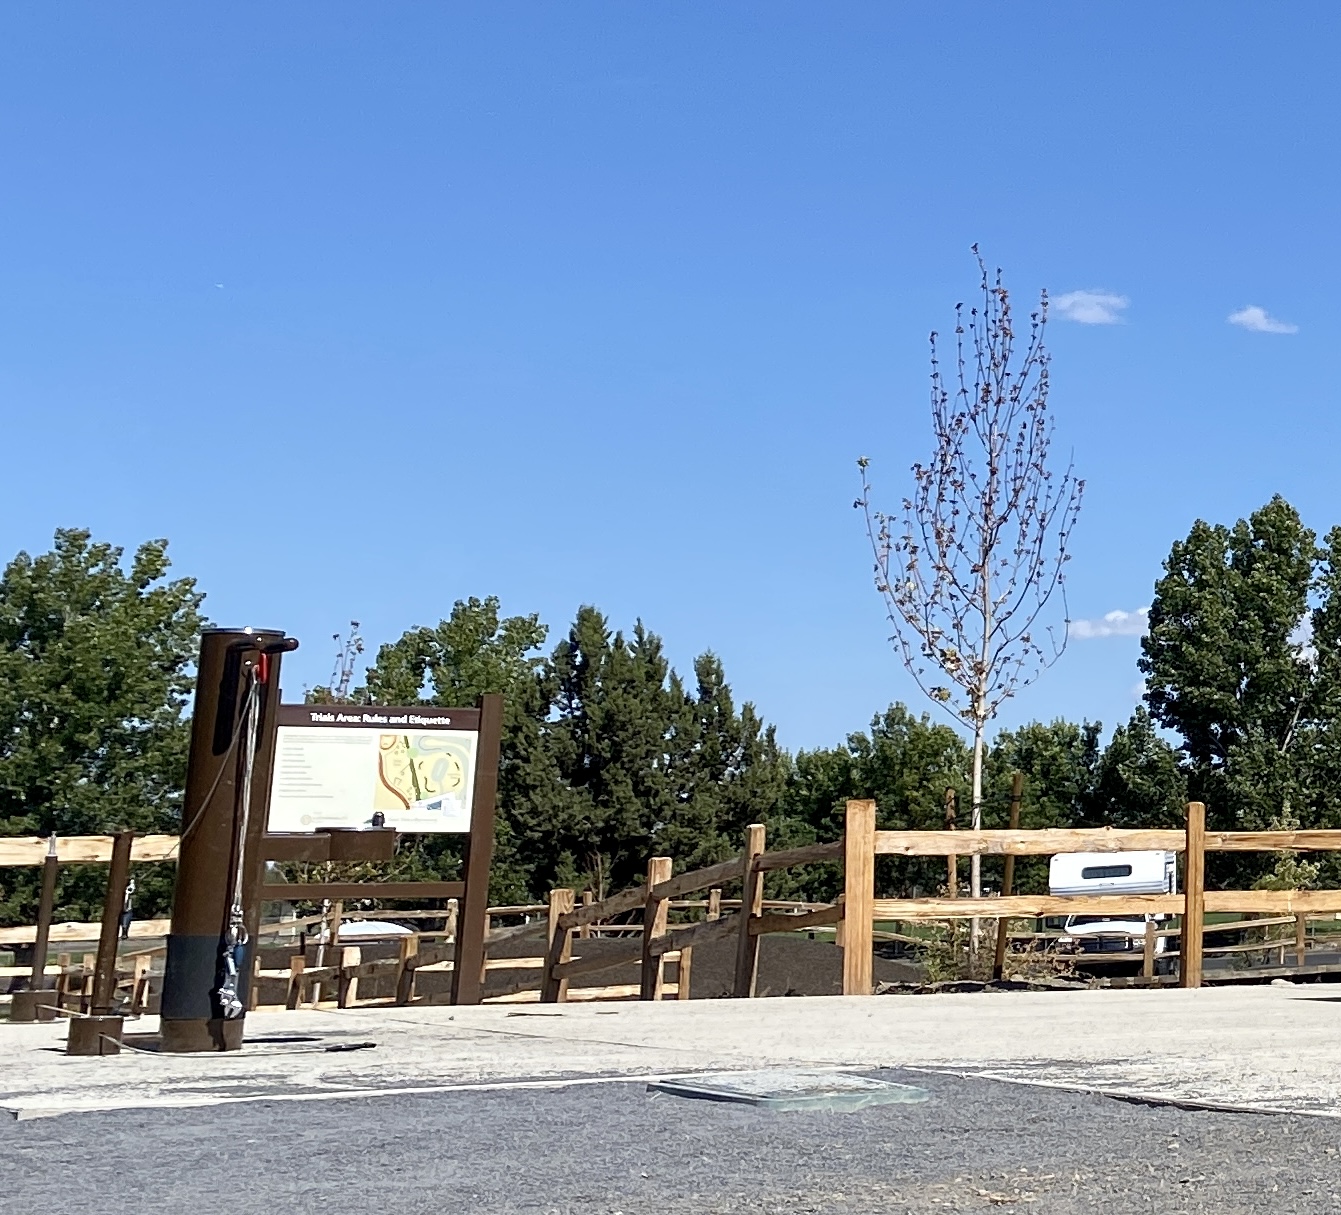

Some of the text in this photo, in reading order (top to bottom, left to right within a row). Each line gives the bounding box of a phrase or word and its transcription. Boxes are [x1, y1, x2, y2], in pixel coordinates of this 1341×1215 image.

[362, 713, 388, 724] Rules
[388, 714, 407, 724] and
[408, 714, 451, 726] Etiquette
